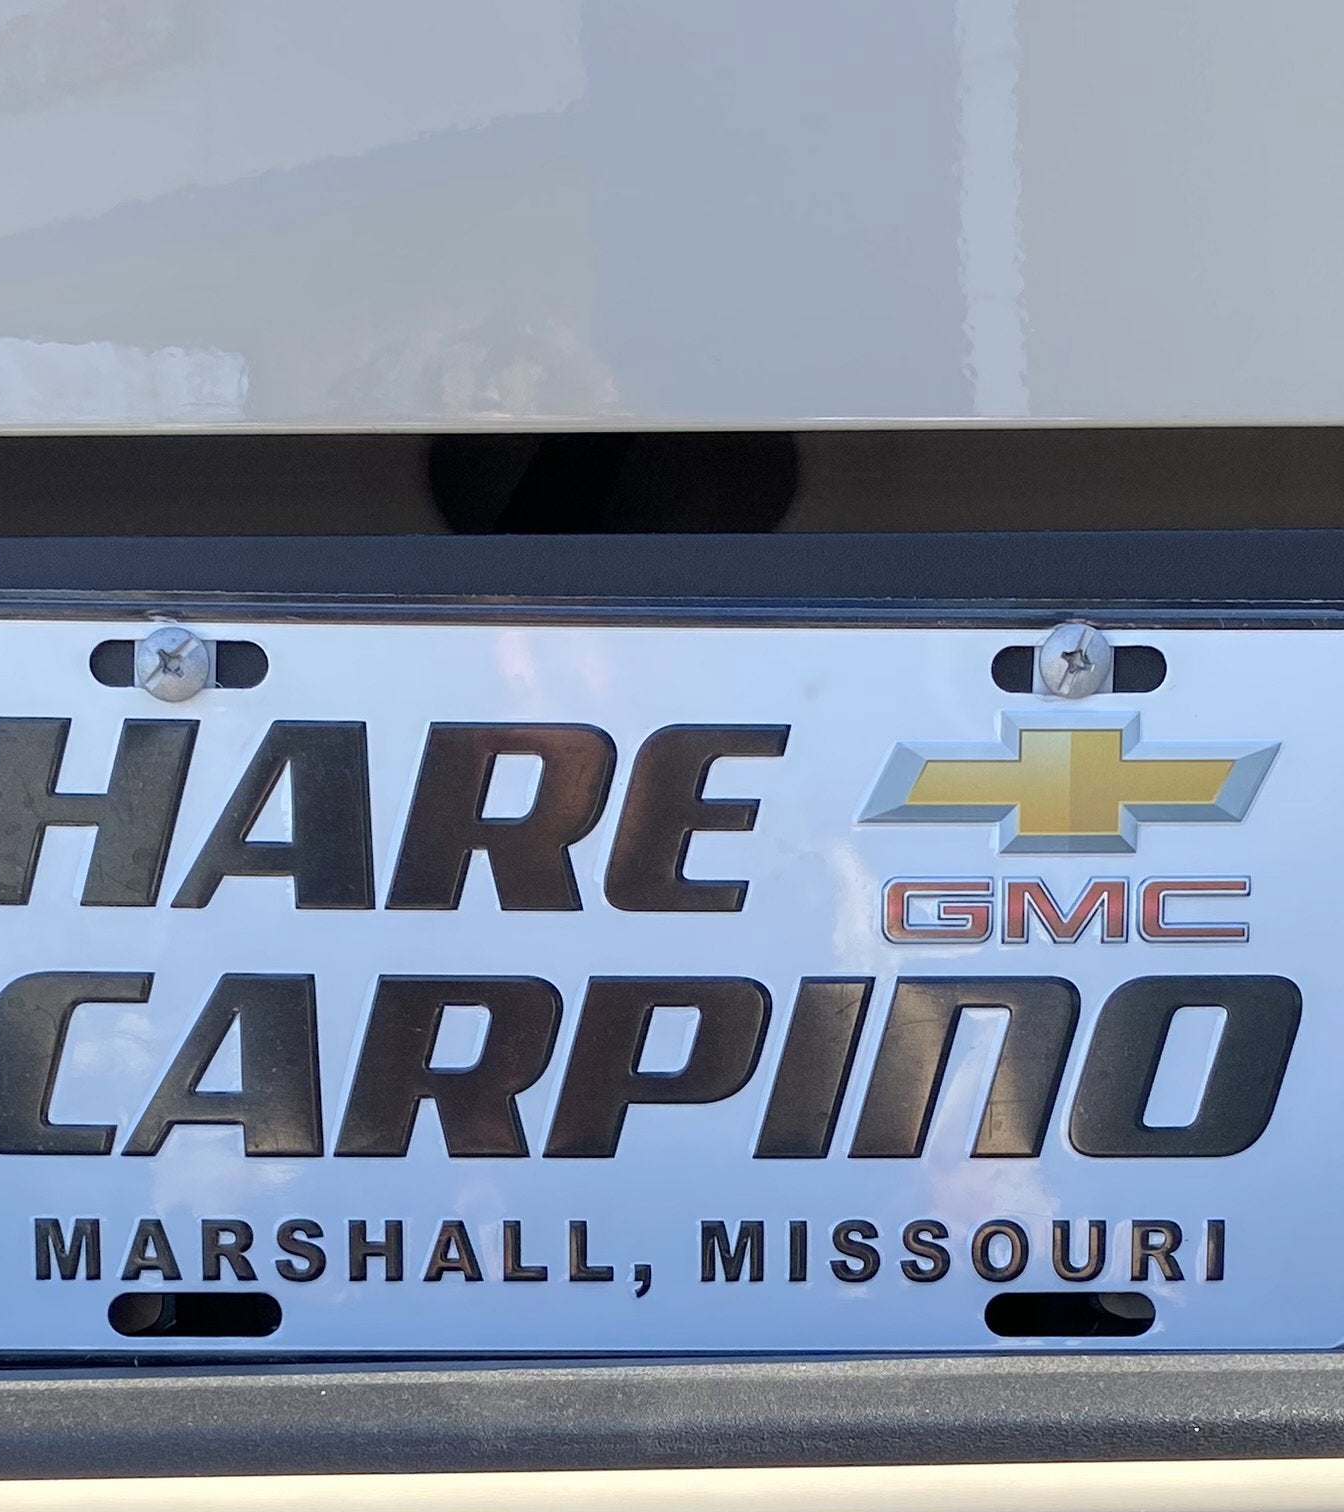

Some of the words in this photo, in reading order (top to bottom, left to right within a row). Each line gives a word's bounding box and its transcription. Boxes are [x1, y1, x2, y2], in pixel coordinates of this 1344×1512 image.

[881, 876, 1251, 945] GMC
[33, 1217, 654, 1299] MARSHALL,
[700, 1218, 1226, 1284] MISSOURI
